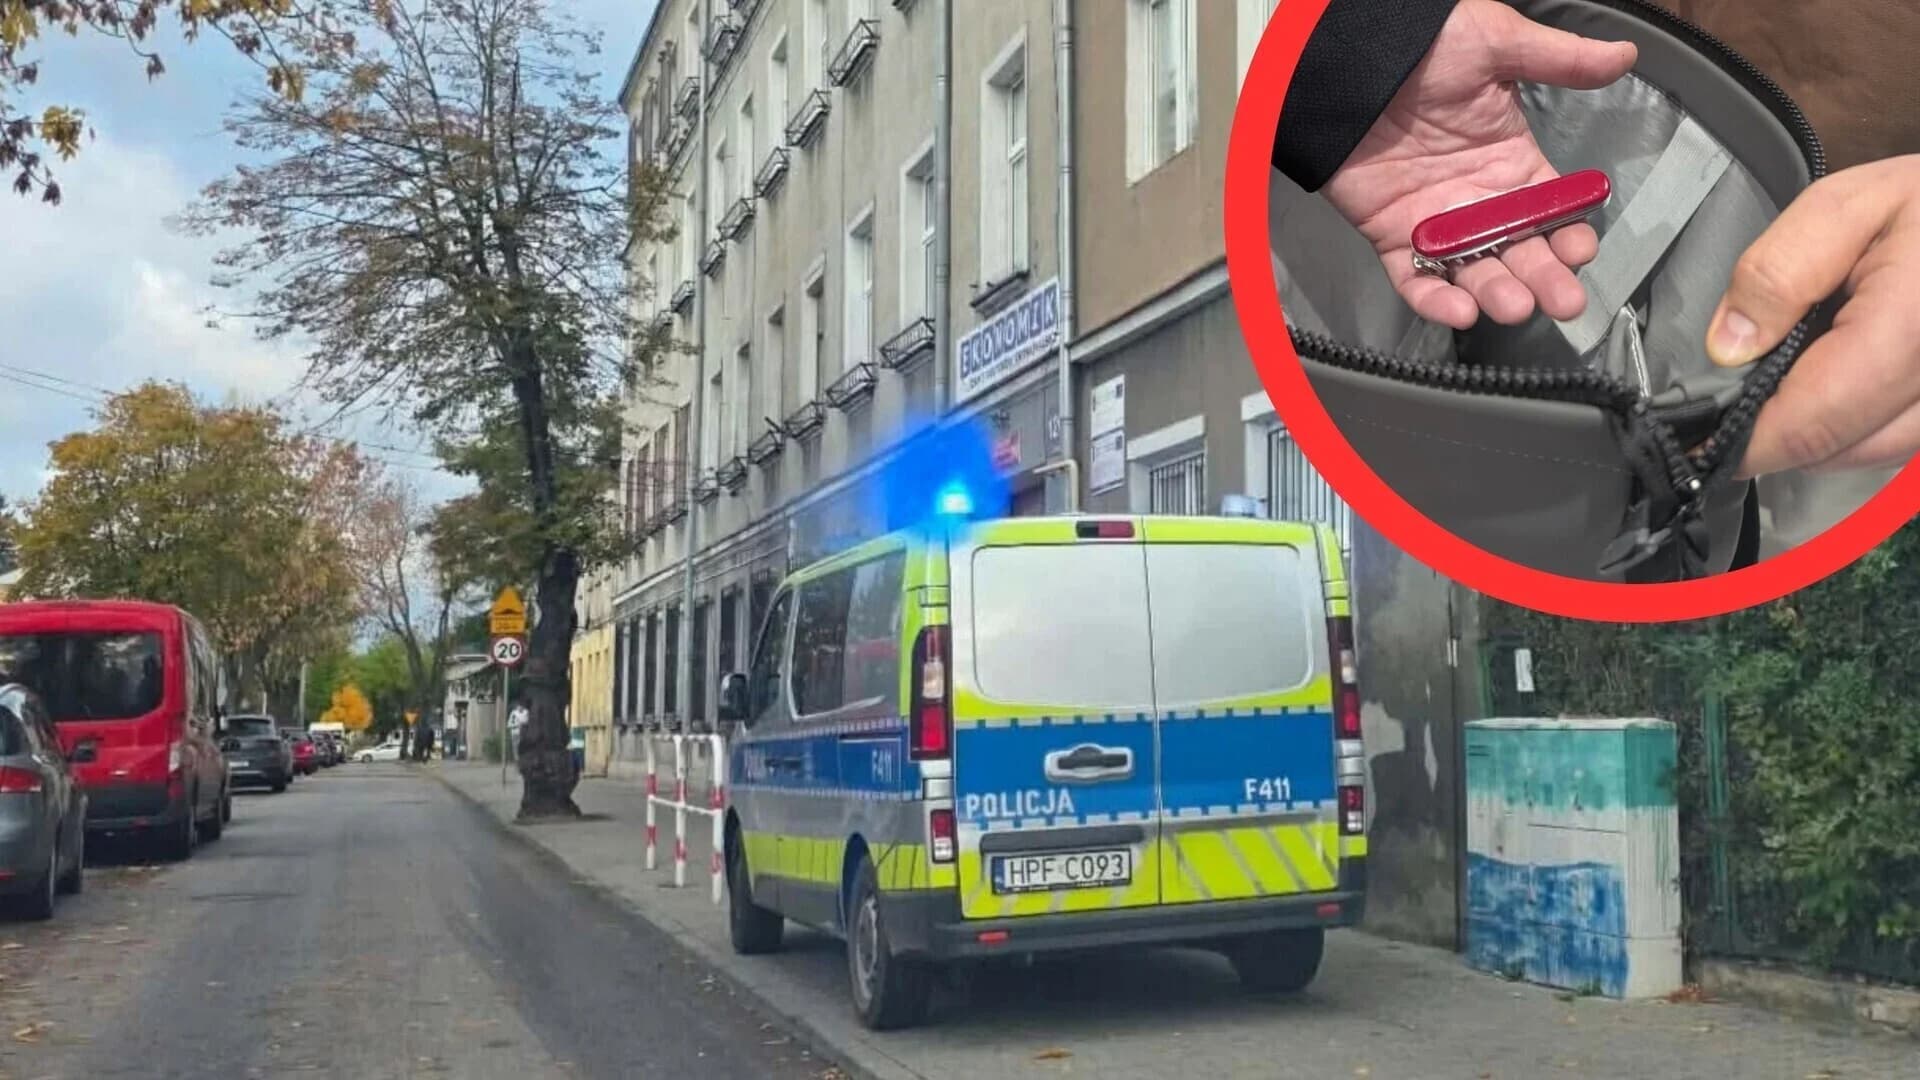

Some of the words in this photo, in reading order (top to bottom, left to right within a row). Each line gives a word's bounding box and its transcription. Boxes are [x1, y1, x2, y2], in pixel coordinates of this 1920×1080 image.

[962, 289, 1056, 375] EKONOMIK
[498, 643, 519, 659] 20
[872, 749, 892, 783] F411
[965, 788, 1075, 819] POLICJA
[1244, 777, 1291, 802] F411
[1009, 857, 1057, 884] HPF
[1065, 853, 1124, 881] C093
